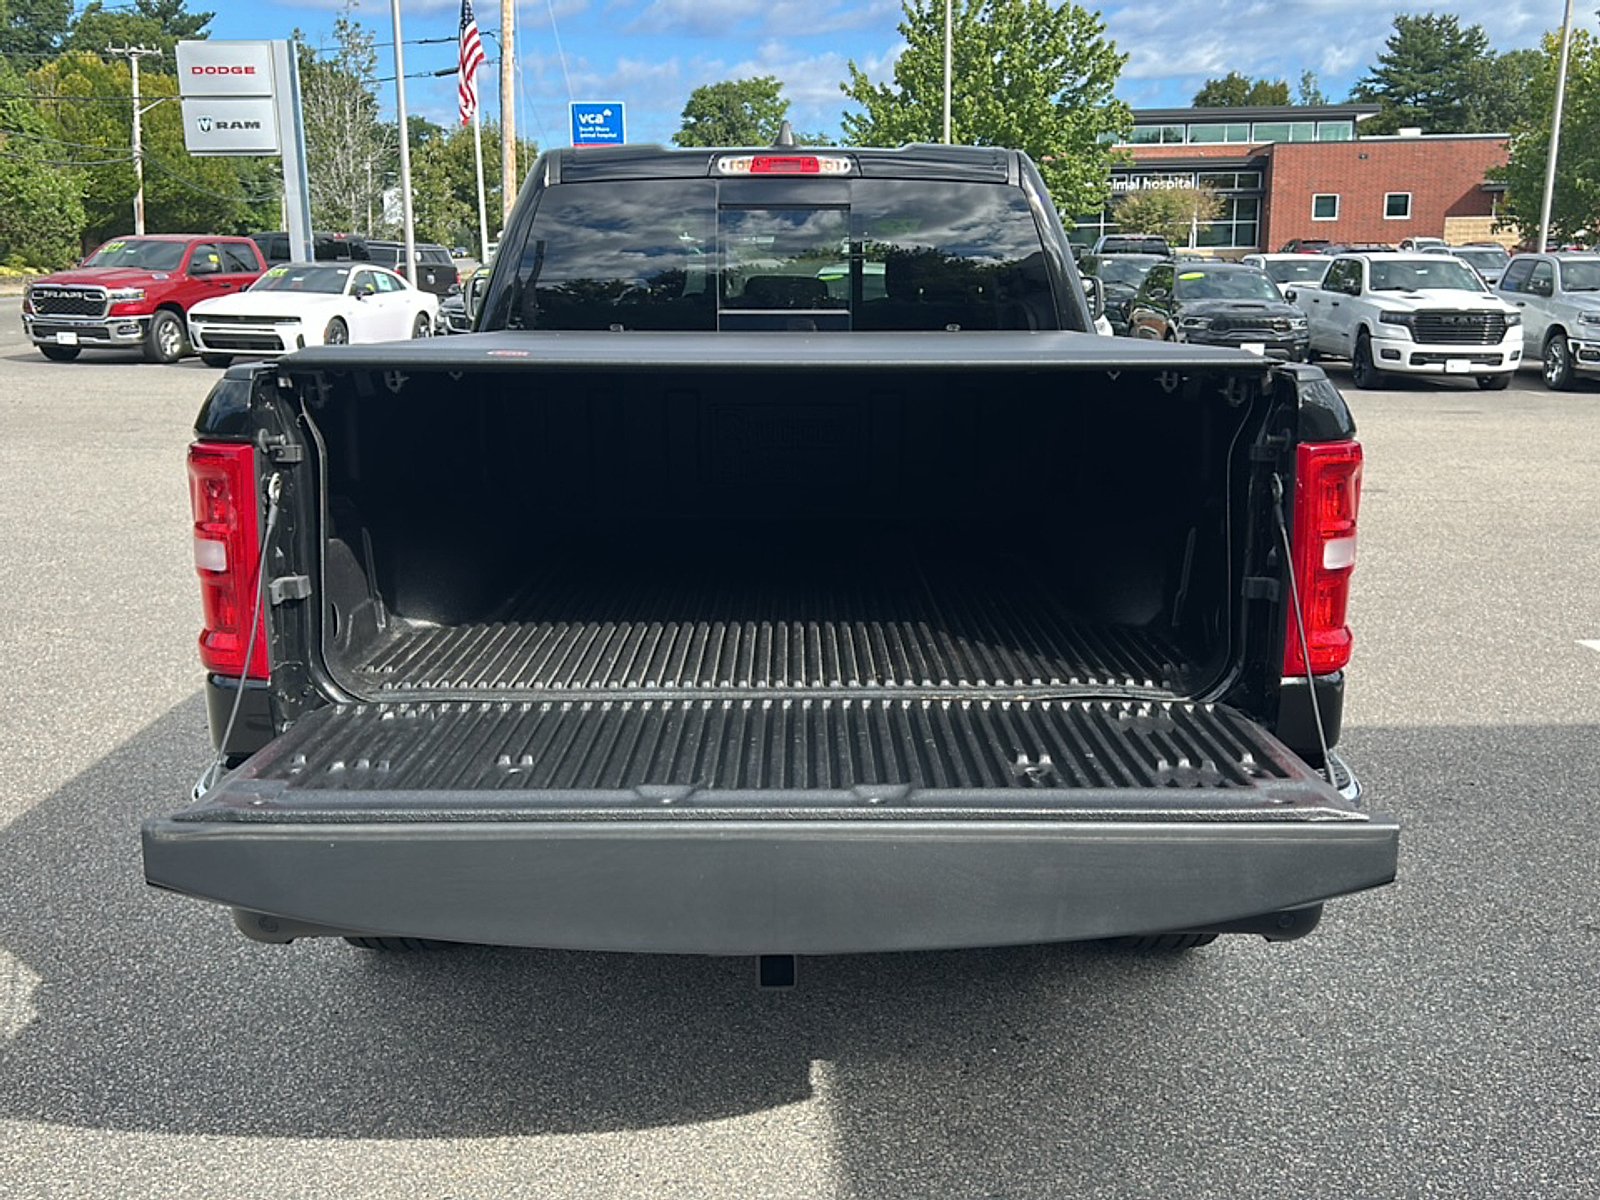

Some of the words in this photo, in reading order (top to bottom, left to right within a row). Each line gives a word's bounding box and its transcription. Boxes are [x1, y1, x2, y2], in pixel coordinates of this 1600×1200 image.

[191, 66, 256, 75] DODGE
[578, 113, 604, 124] vca
[215, 121, 261, 130] RAM
[1143, 176, 1195, 190] hospital
